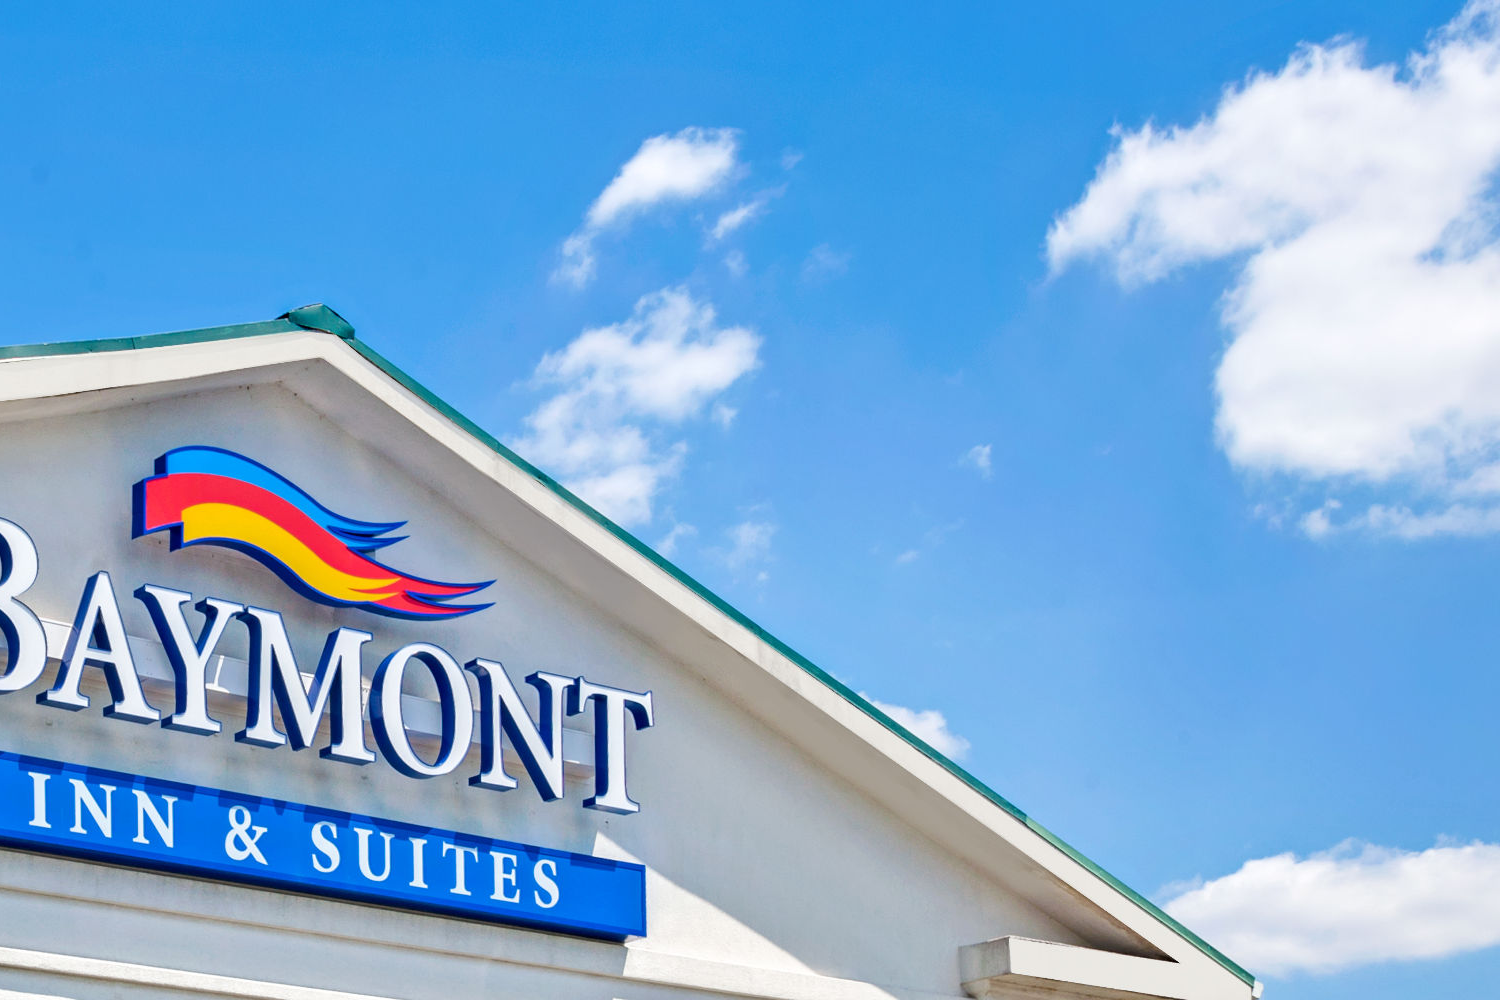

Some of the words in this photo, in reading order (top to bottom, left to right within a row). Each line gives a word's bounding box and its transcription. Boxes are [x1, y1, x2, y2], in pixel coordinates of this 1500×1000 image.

[27, 771, 178, 849] INN
[224, 806, 268, 866] &
[310, 820, 561, 910] SUITES
